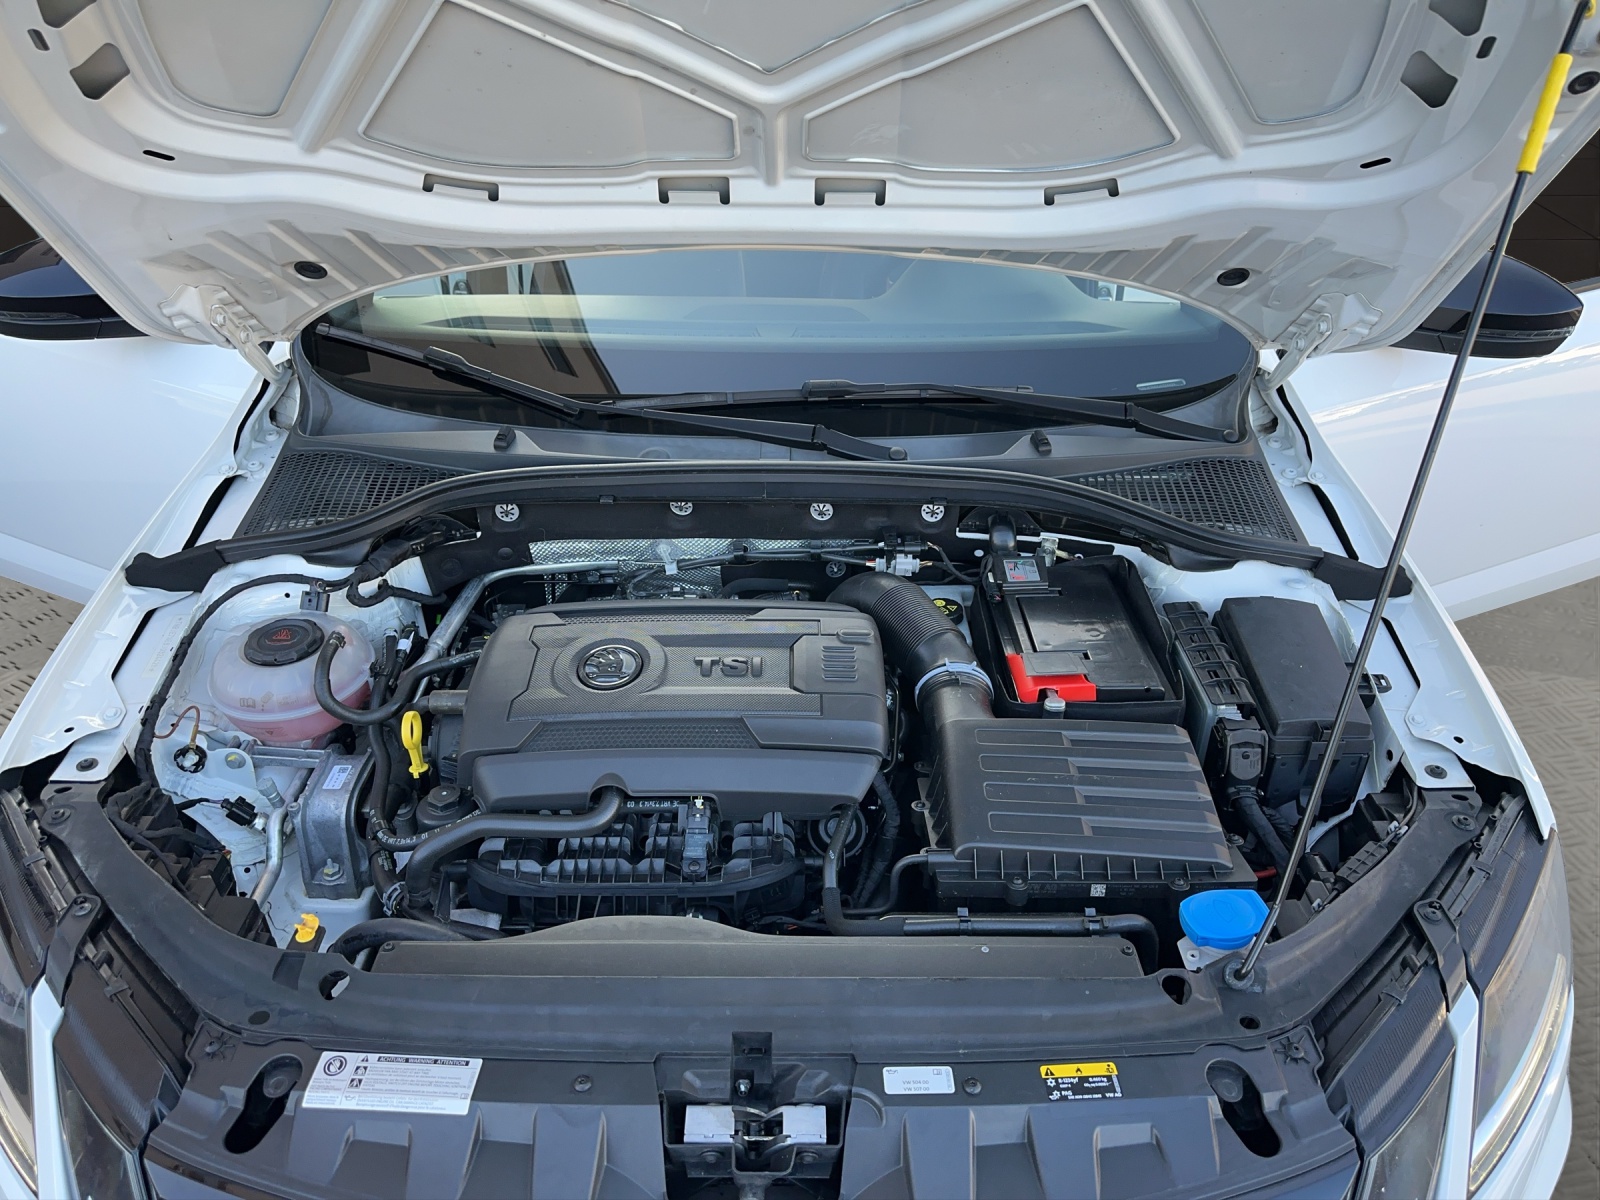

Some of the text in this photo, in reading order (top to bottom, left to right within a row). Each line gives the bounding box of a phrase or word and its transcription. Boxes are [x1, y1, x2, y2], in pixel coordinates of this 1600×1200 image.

[694, 656, 762, 677] TSI
[408, 1057, 435, 1065] WARNING
[436, 1058, 468, 1067] ATTENTION
